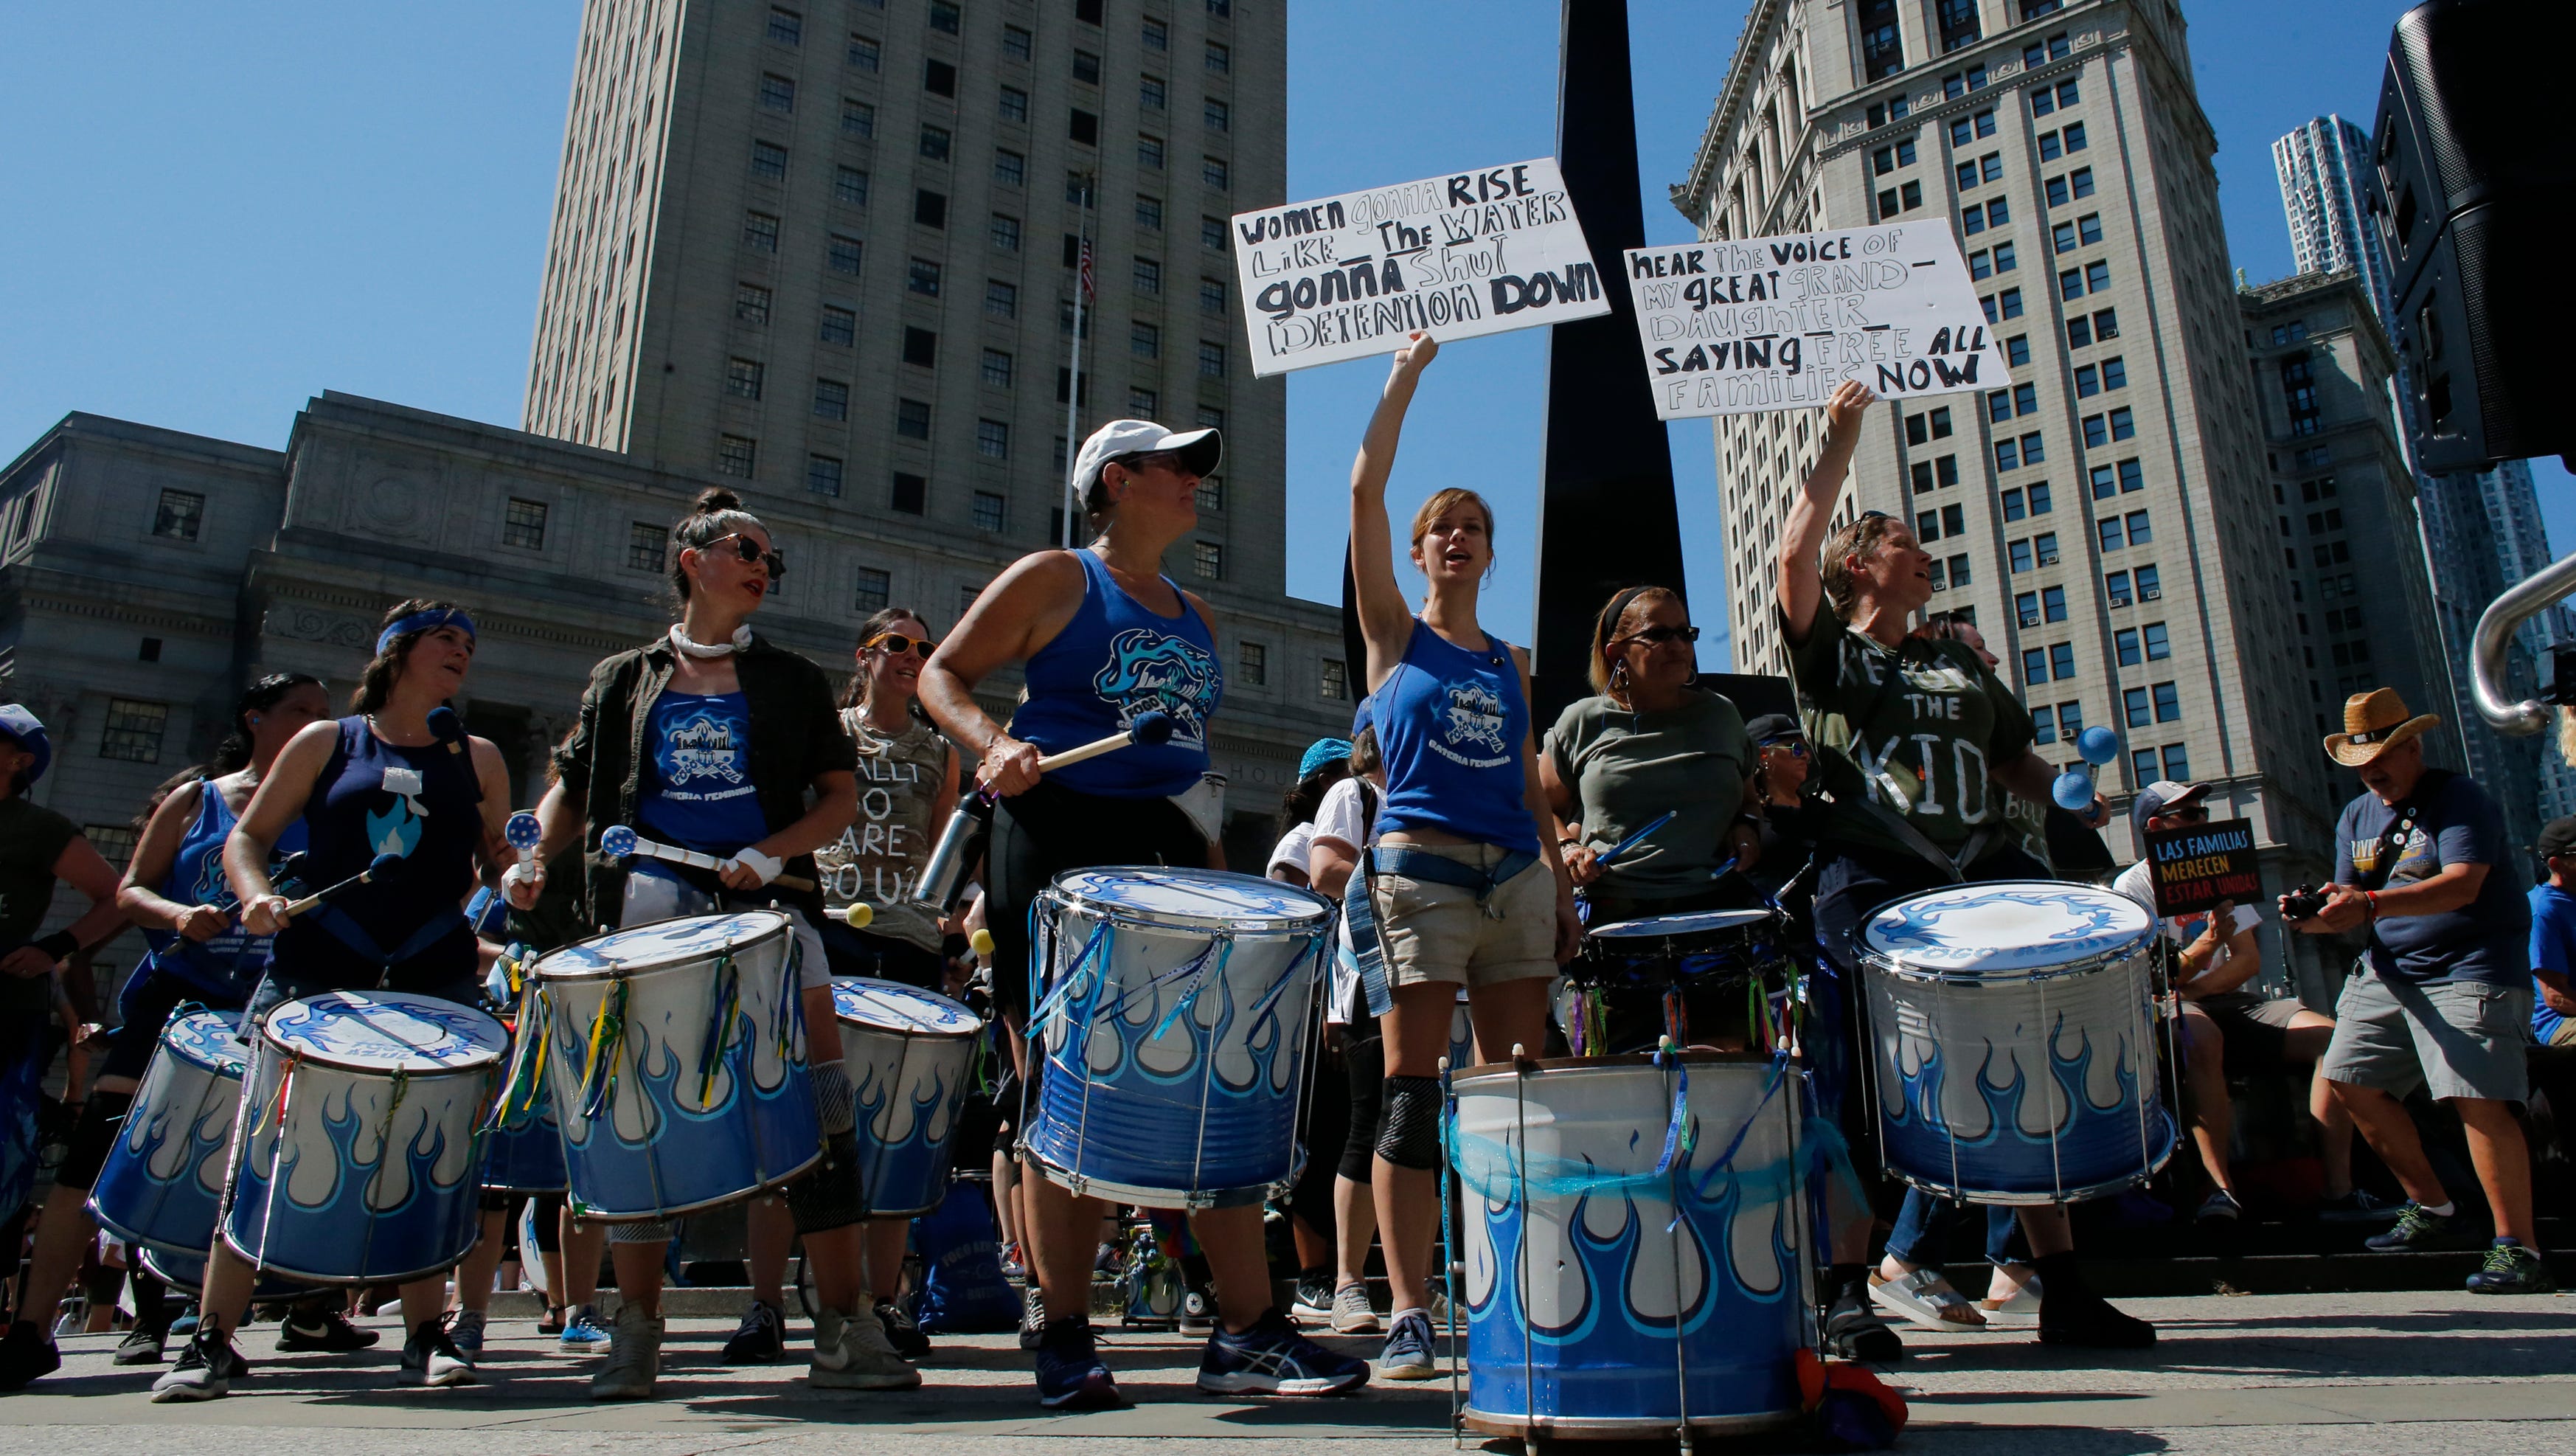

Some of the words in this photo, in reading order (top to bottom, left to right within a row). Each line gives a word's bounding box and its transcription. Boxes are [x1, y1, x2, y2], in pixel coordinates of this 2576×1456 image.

[1448, 164, 1535, 207] RISE
[1440, 190, 1567, 240] WATER
[1863, 229, 1903, 256] OF
[1642, 281, 1678, 311] MY
[1813, 327, 1913, 365] FREE
[1928, 325, 1987, 356] ALL
[1877, 353, 1979, 394] NOW
[1125, 696, 1160, 719] FOGO
[1903, 693, 1961, 721] THE
[1448, 721, 1469, 743] FOGO
[1428, 739, 1468, 766] BATERIA
[674, 759, 698, 785] FOGO
[1230, 763, 1300, 786] HOU
[661, 788, 702, 801] BATERIA
[704, 785, 757, 802] FEMININA
[837, 822, 907, 858] ARE
[2156, 839, 2184, 862] LAS
[2187, 830, 2249, 856] FAMILIAS
[2160, 854, 2231, 884] MERECEN
[2165, 880, 2215, 905] ESTAR
[2216, 873, 2258, 896] UNIDAS
